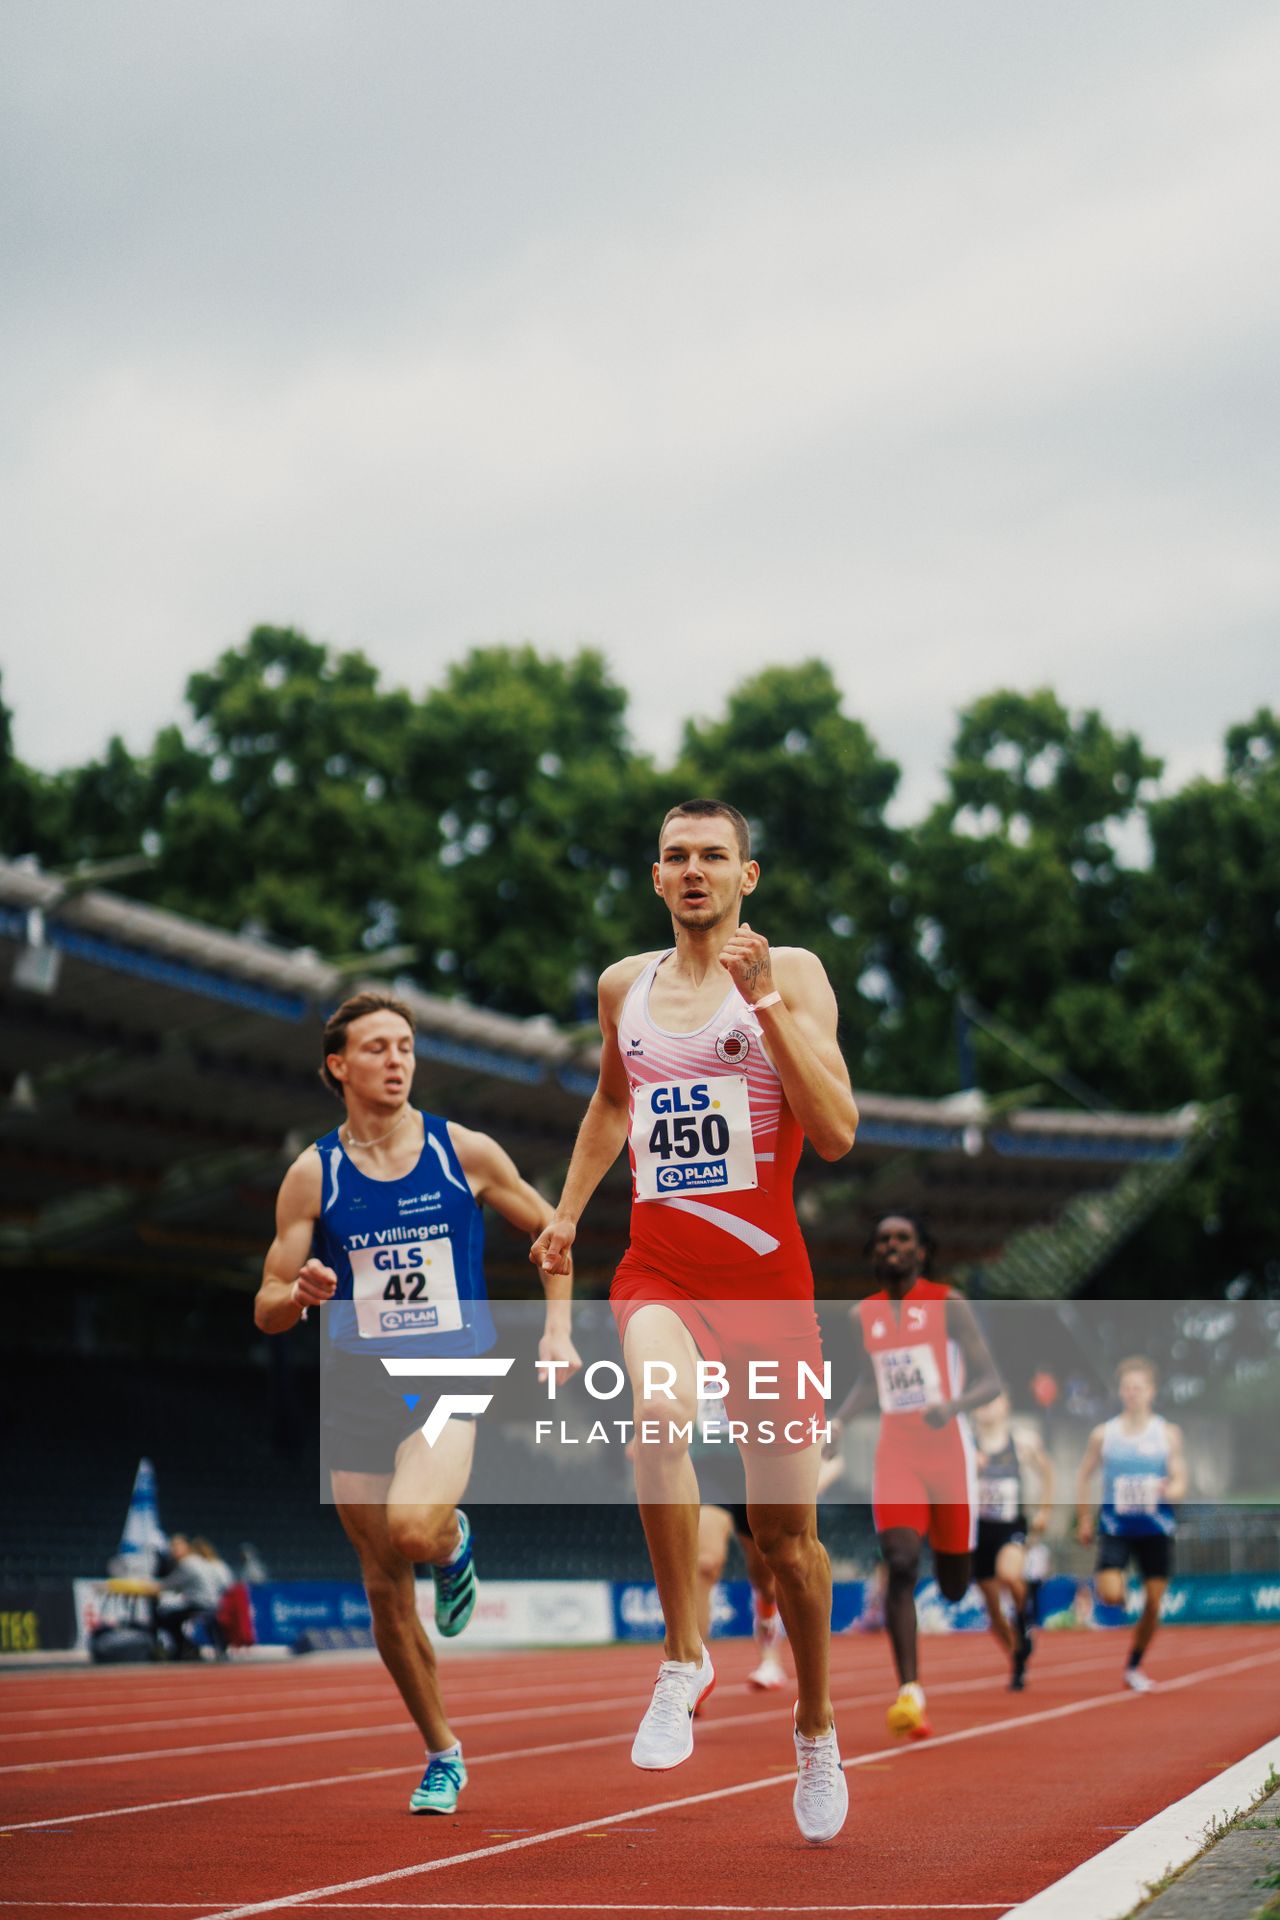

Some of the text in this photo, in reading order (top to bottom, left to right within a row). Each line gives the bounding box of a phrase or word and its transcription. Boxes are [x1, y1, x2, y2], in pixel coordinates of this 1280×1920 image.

[649, 1114, 730, 1160] 450
[685, 1165, 724, 1179] PLAN
[349, 1223, 449, 1248] TV Villingen
[383, 1272, 428, 1305] 42
[404, 1310, 435, 1322] PLAN
